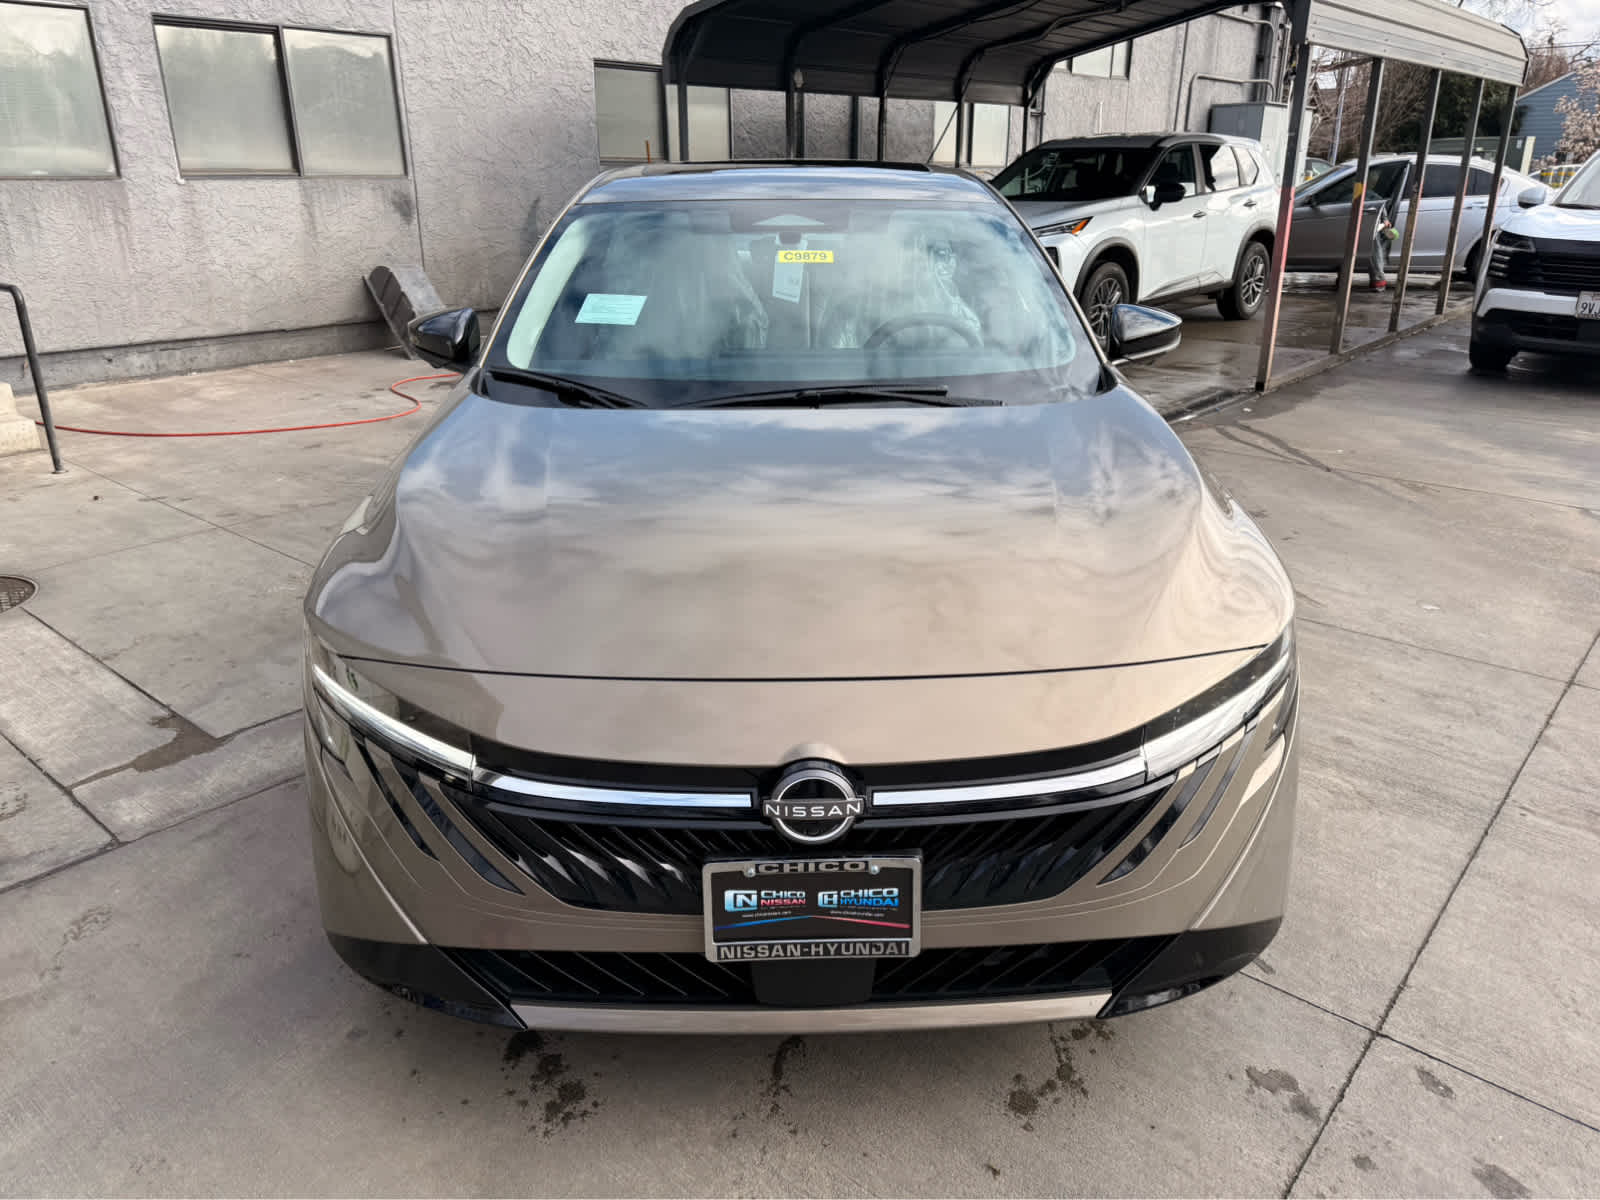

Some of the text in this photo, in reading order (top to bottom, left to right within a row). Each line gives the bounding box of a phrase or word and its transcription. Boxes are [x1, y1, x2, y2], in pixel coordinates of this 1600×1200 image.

[783, 251, 827, 261] C9879
[765, 802, 860, 817] NISSAN
[758, 860, 866, 873] CHICO
[760, 890, 806, 899] CHICO
[840, 888, 899, 898] CHICO
[840, 898, 899, 907] HYUNDAI
[720, 942, 907, 959] NISSAN-HYUNDAI
